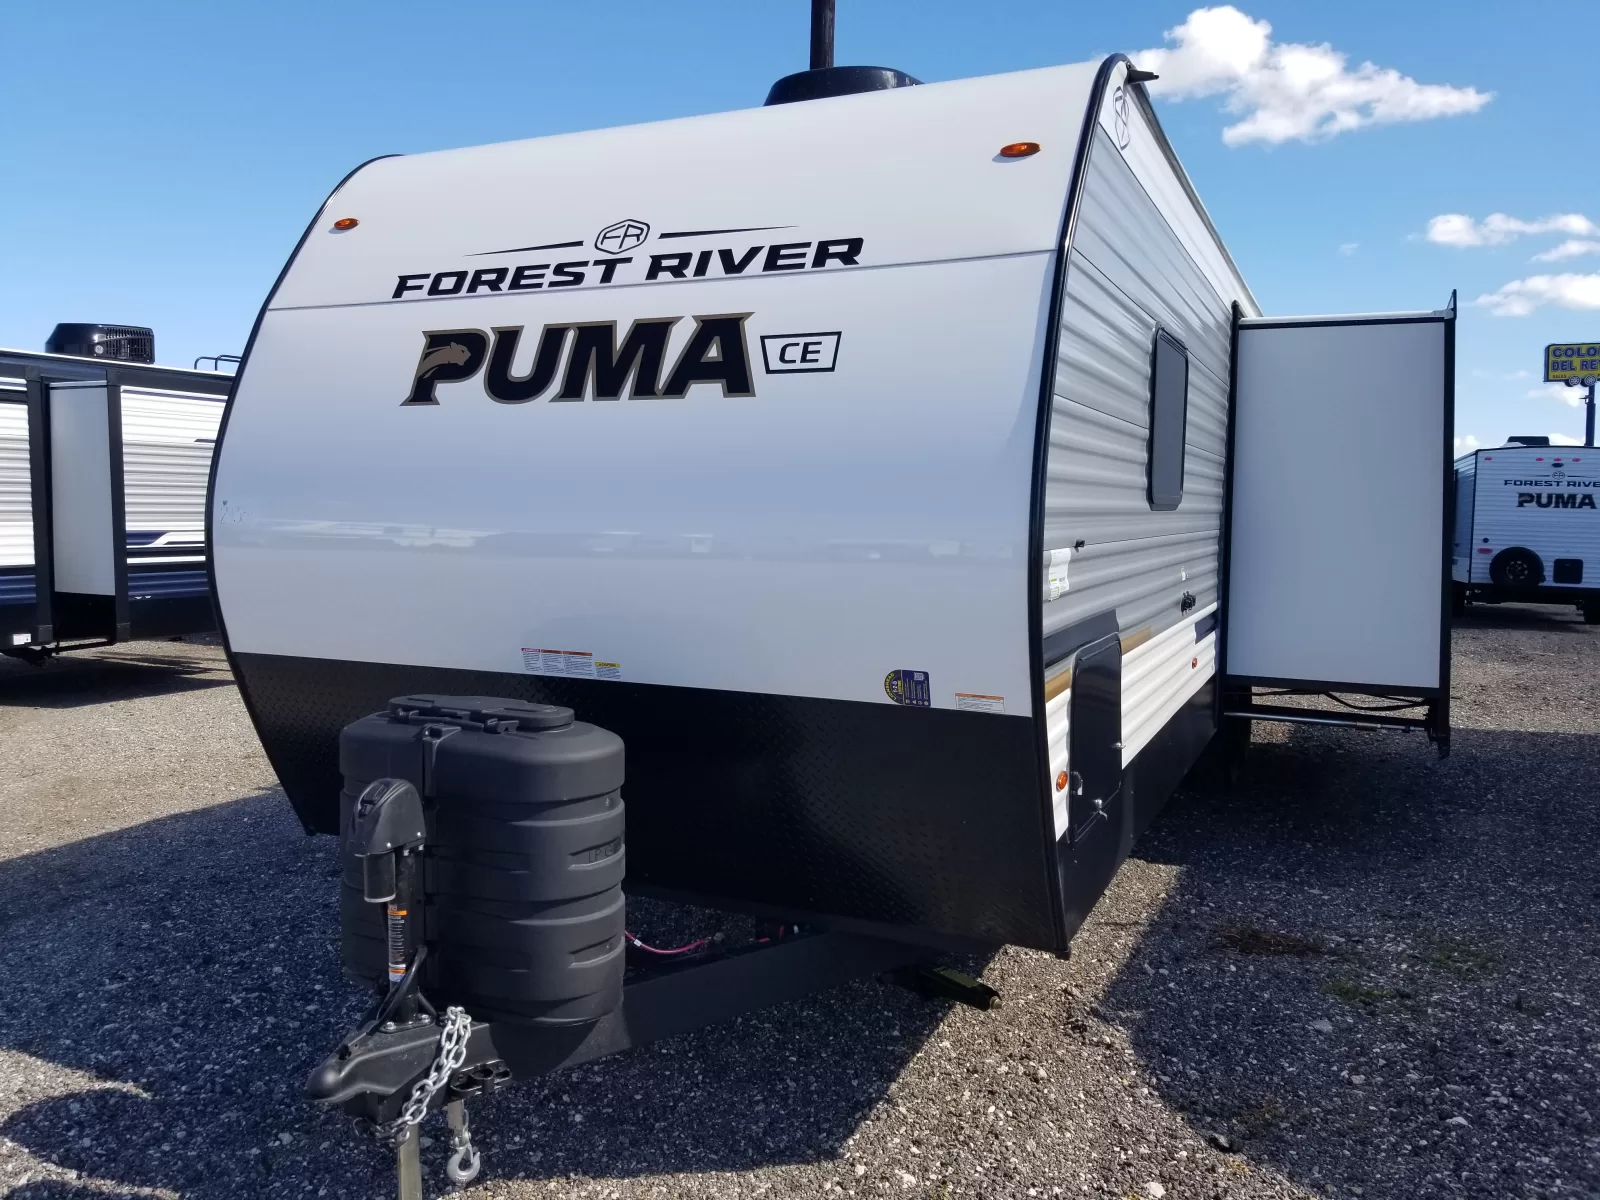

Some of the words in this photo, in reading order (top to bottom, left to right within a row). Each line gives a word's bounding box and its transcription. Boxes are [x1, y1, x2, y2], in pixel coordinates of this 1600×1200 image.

[391, 256, 633, 299] FOREST
[645, 237, 865, 281] RIVER
[399, 312, 756, 406] PUMA
[778, 341, 823, 364] CE
[1552, 347, 1600, 358] COLO
[1551, 360, 1576, 371] DEL
[1504, 479, 1563, 487] FOREST
[1516, 492, 1597, 509] PUMA
